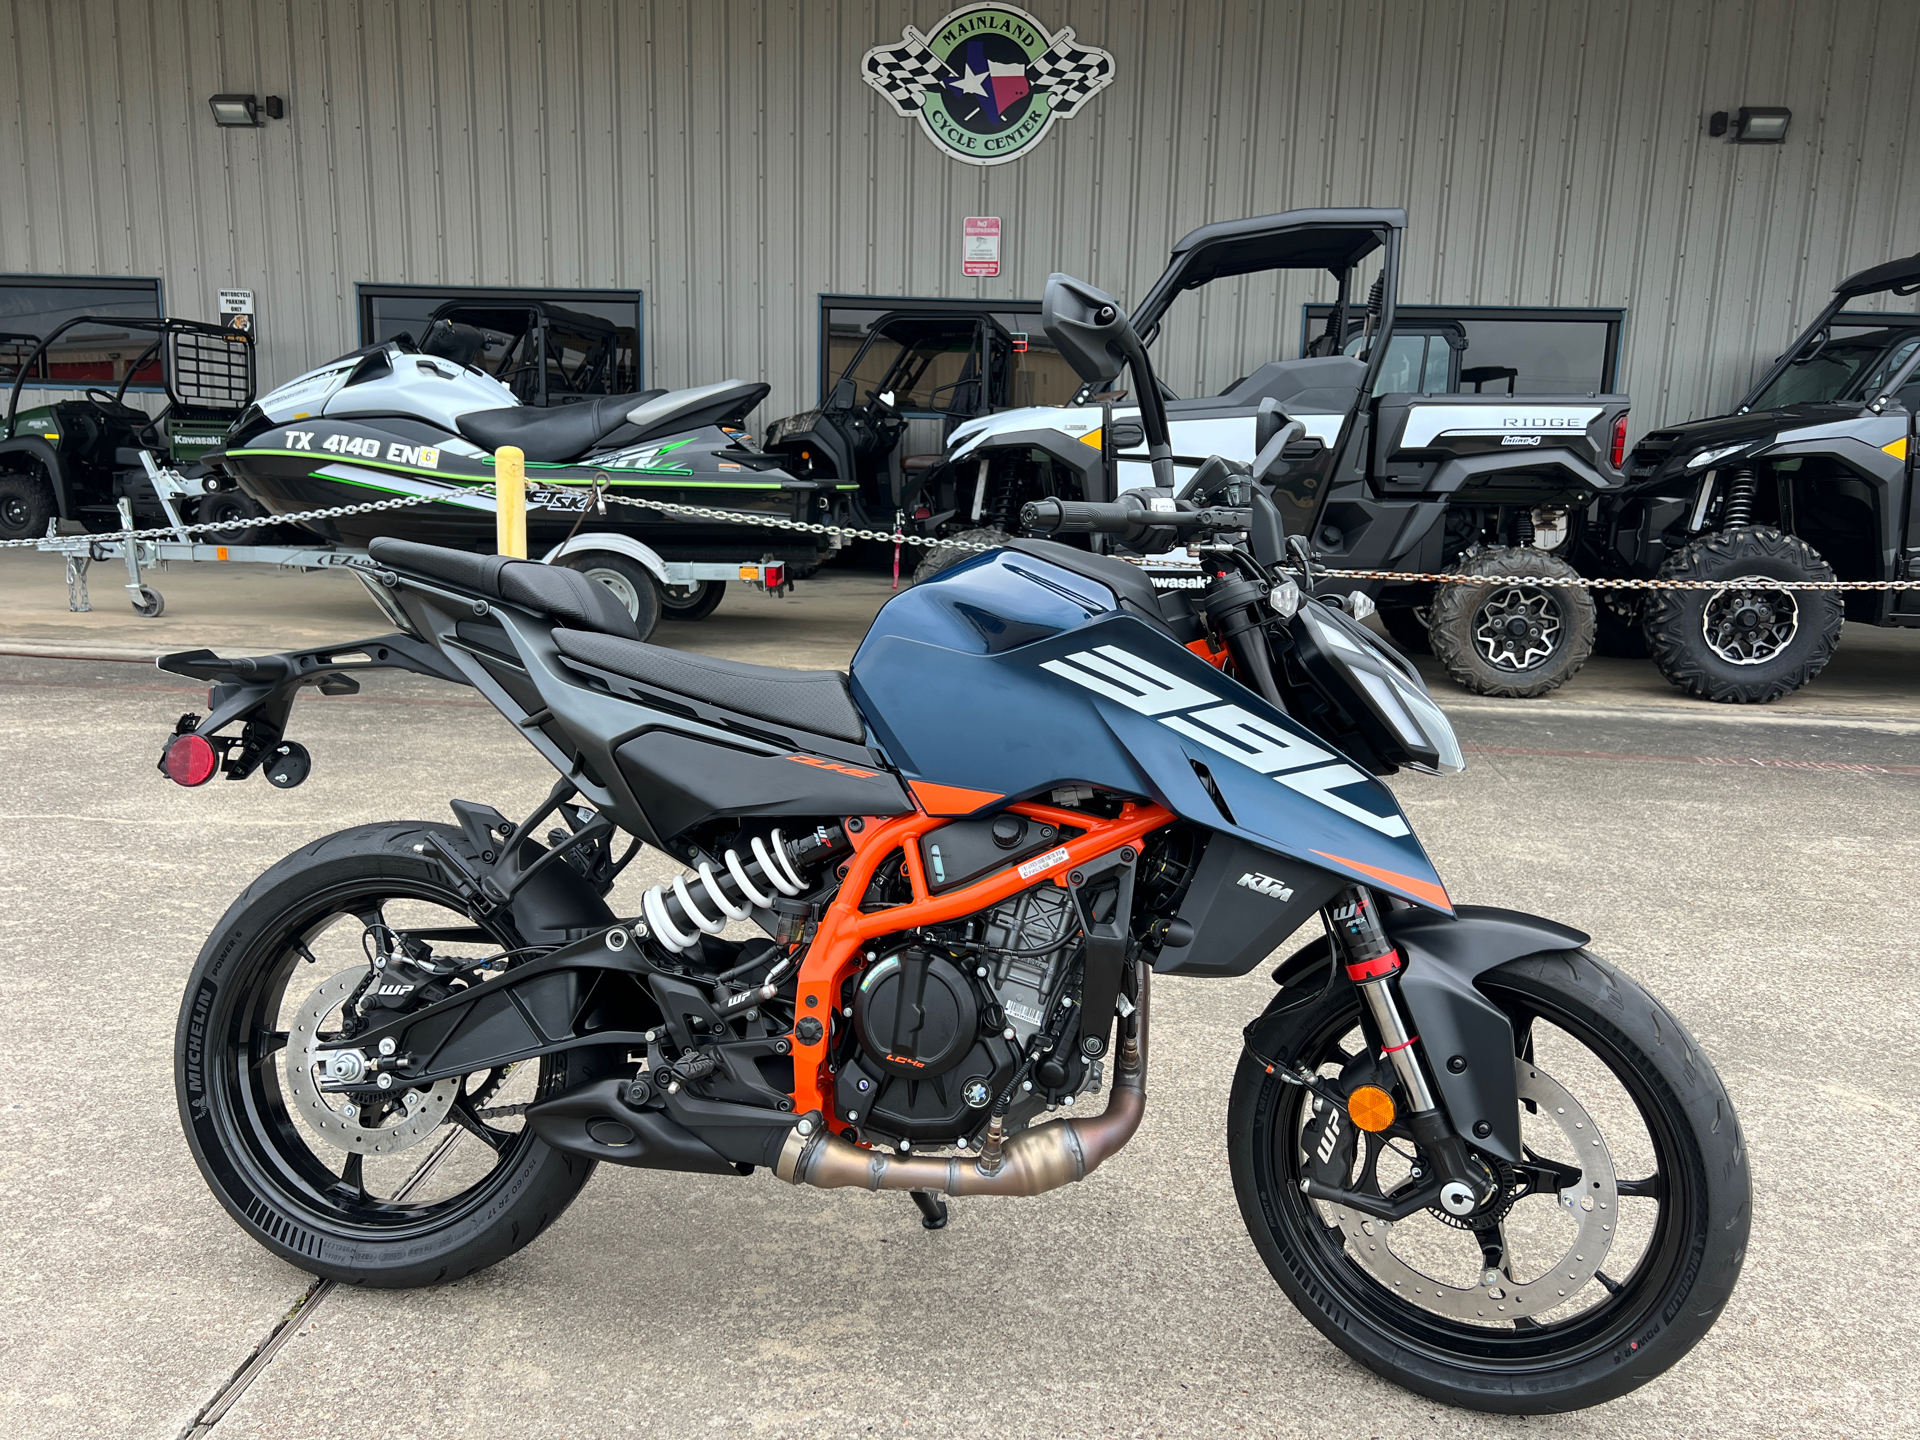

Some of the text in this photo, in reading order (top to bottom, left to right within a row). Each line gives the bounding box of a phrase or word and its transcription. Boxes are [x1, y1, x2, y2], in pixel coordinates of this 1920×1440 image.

[942, 15, 1035, 48] MAINLAND
[932, 110, 1042, 151] CYCLE CENTER
[1503, 418, 1580, 427] RIDGE
[174, 434, 222, 446] Kawasaki
[285, 430, 420, 465] TX 4140 EN
[1236, 872, 1295, 903] KTM
[1333, 898, 1370, 921] WP
[1345, 916, 1367, 928] APEX
[212, 930, 243, 977] POWER 6
[378, 984, 415, 996] WP
[727, 990, 752, 1008] WP
[188, 986, 213, 1093] MICHELIN
[1316, 1107, 1341, 1164] WP
[511, 1157, 538, 1195] 150/60
[498, 1194, 510, 1210] ZR
[1262, 1201, 1277, 1228] FRONT
[1666, 1250, 1700, 1319] MICHELIN
[1613, 1355, 1621, 1365] 6
